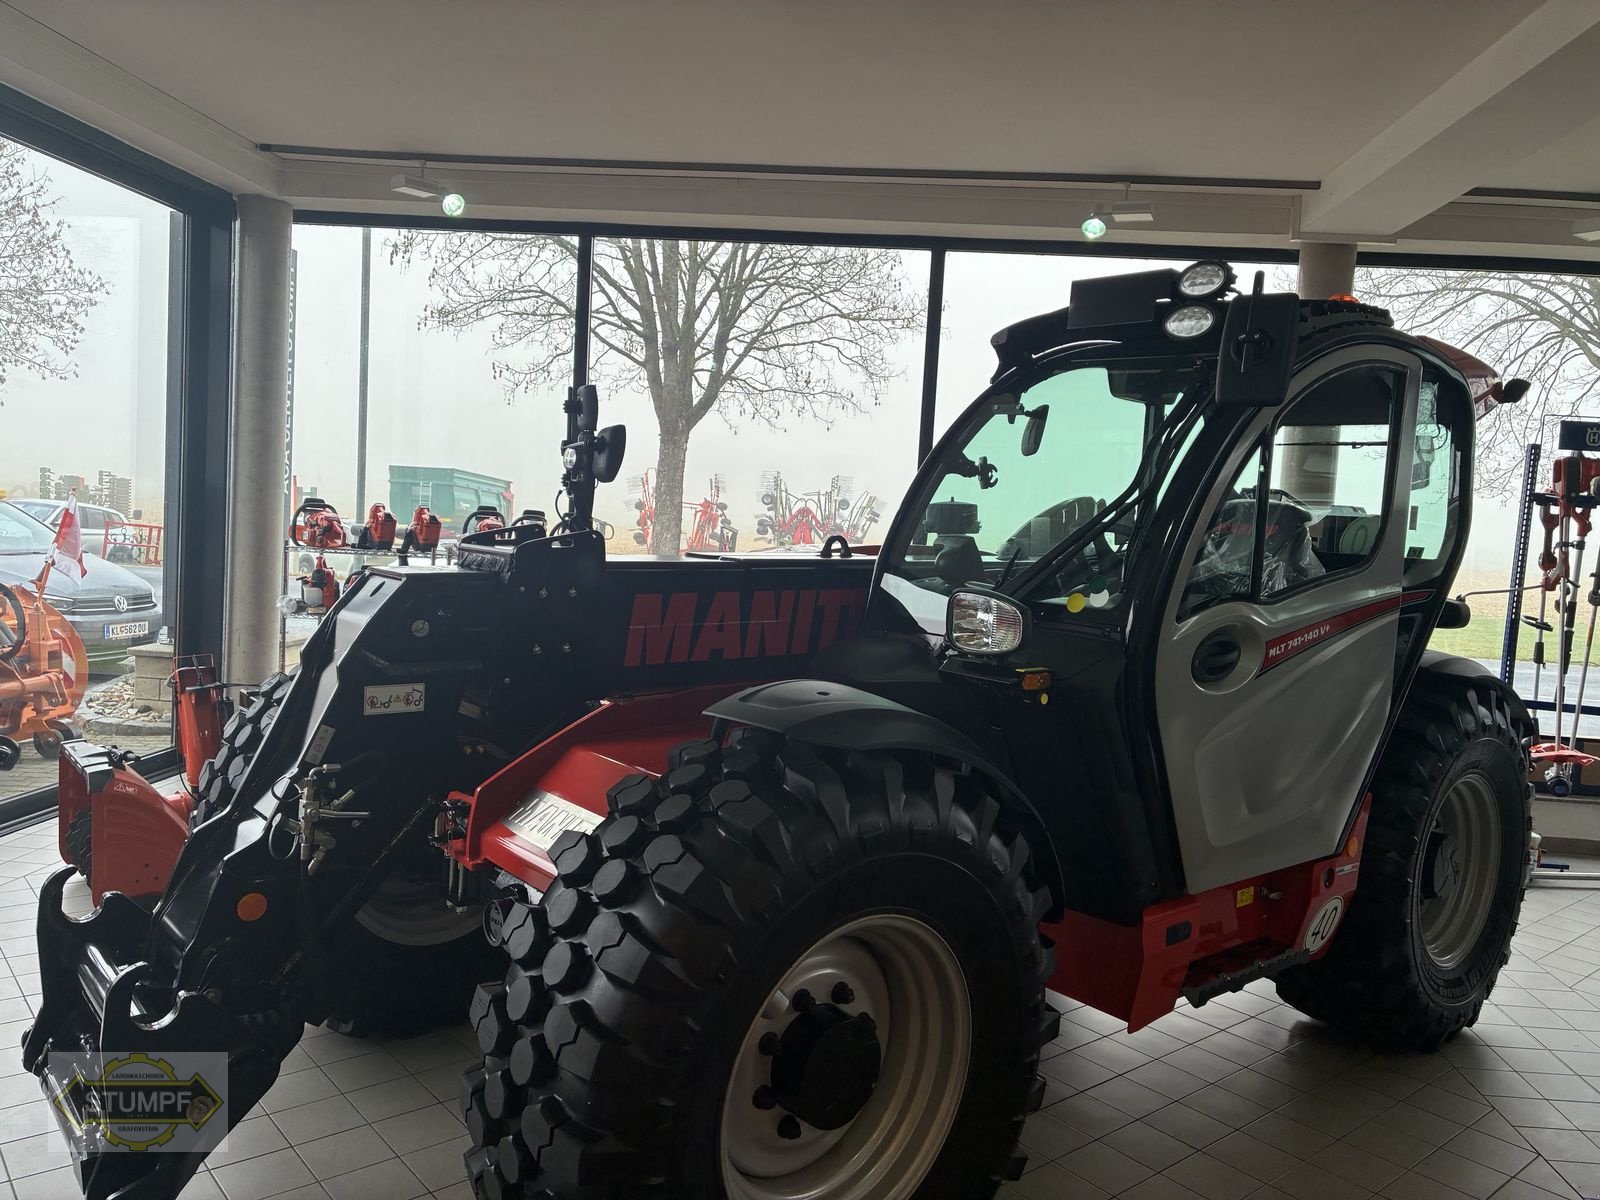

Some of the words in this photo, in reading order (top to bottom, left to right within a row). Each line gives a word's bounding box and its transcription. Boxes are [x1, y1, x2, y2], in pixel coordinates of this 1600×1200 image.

[623, 588, 865, 667] MANIT
[1268, 643, 1286, 658] MLT
[1287, 629, 1319, 650] 741-140
[1320, 624, 1330, 635] V+
[1310, 906, 1338, 944] 40
